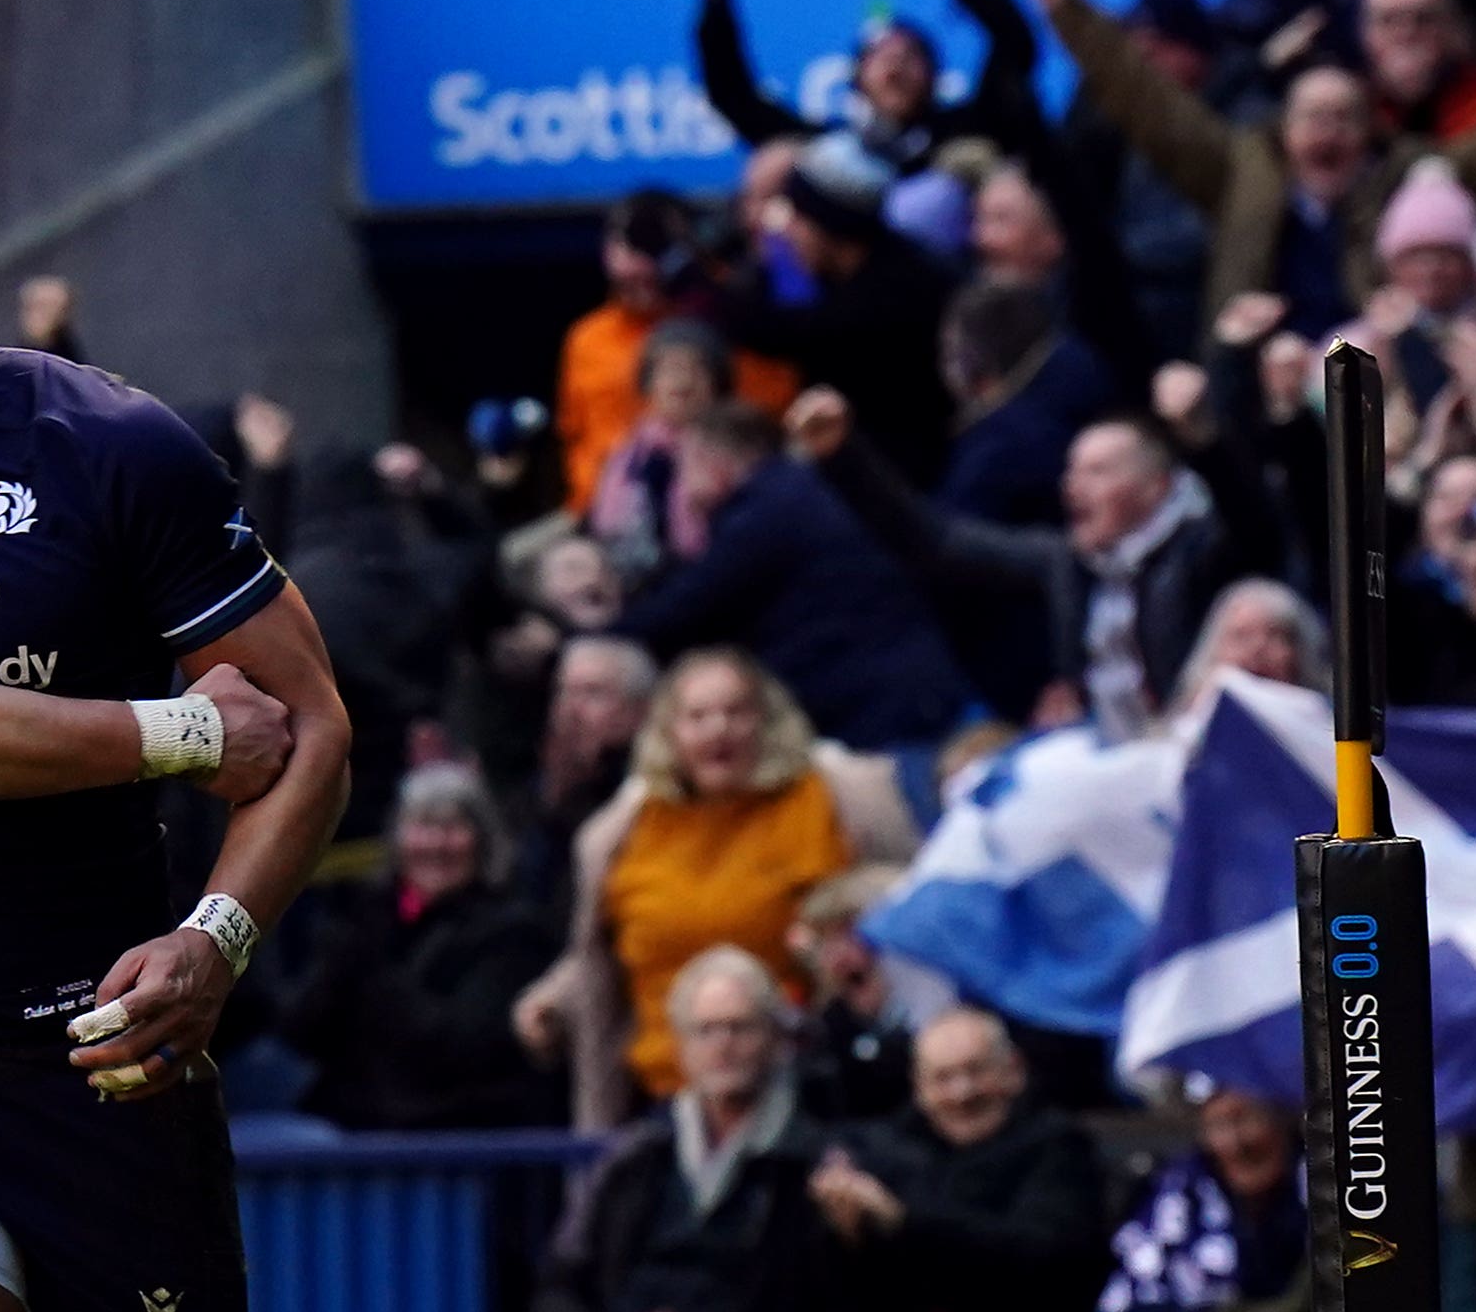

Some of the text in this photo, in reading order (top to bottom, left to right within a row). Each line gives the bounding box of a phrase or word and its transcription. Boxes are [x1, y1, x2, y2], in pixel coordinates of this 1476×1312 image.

[431, 70, 737, 166] Scottis
[1330, 914, 1387, 1220] GUINNESS 0.0
